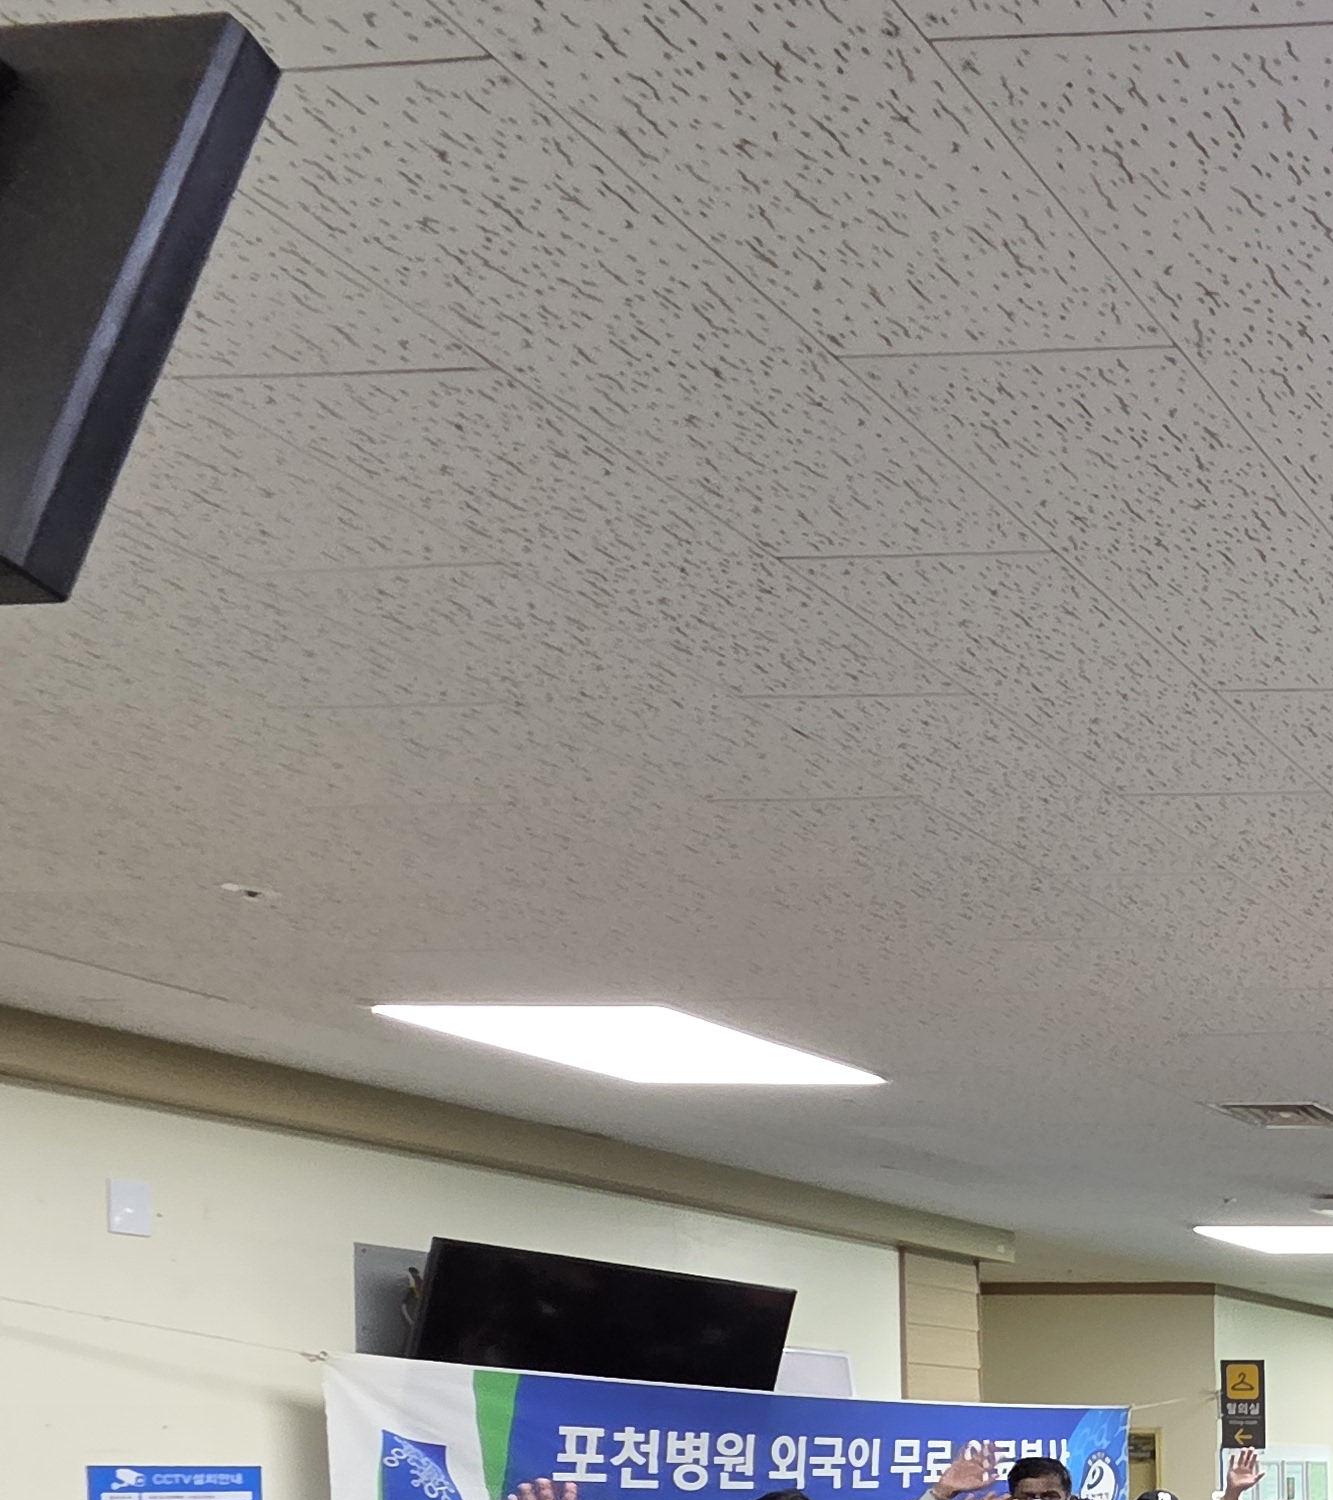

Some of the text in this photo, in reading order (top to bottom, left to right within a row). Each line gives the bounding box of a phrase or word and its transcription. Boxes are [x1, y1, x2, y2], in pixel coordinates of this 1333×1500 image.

[552, 1425, 756, 1491] 포천병원
[768, 1434, 881, 1490] 외국인
[890, 1438, 951, 1488] 무료
